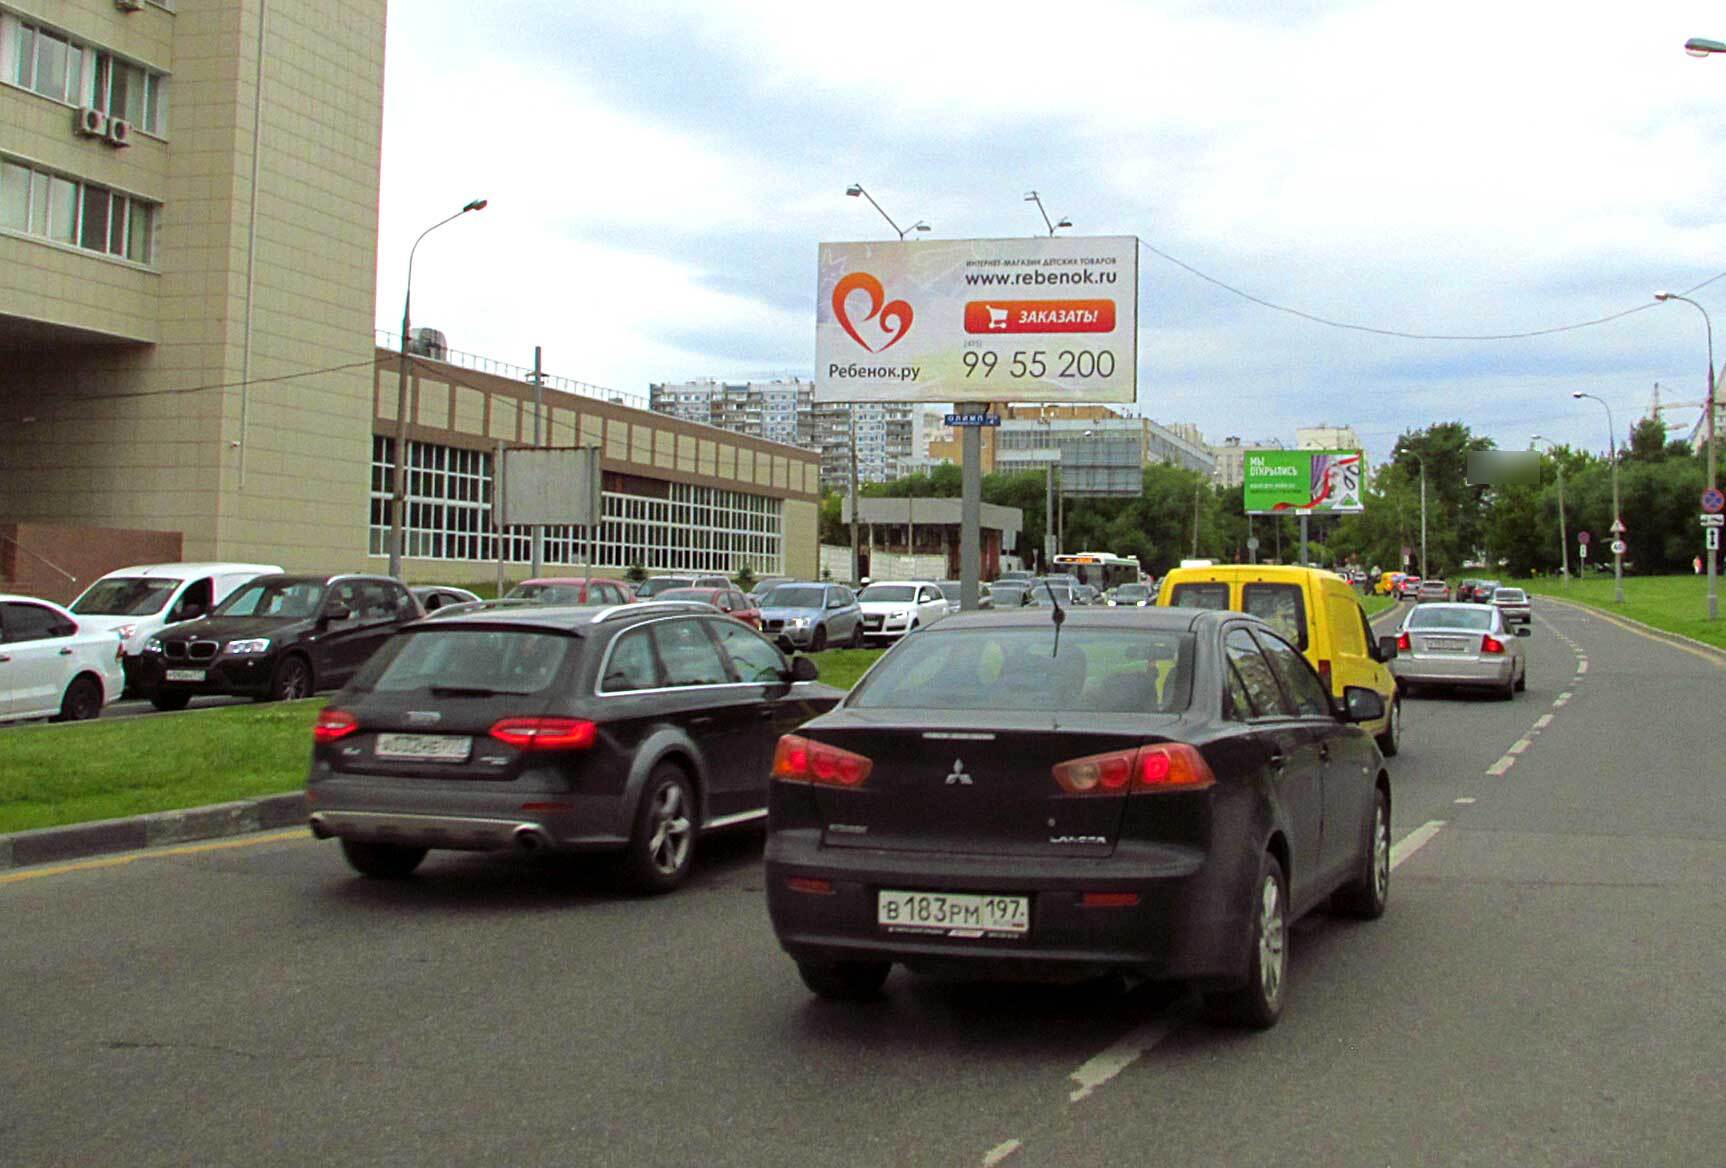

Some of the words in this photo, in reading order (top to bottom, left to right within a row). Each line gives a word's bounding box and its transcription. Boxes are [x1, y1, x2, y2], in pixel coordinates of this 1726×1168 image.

[1080, 257, 1117, 266] ТОВАРОВ
[965, 269, 1117, 285] www.rebenok.ru
[1018, 310, 1099, 324] ЗАКАЗАТЬ!
[829, 363, 920, 381] Ребенок.ру
[963, 351, 998, 378] 99
[1009, 351, 1047, 378] 55
[1058, 350, 1115, 378] 200
